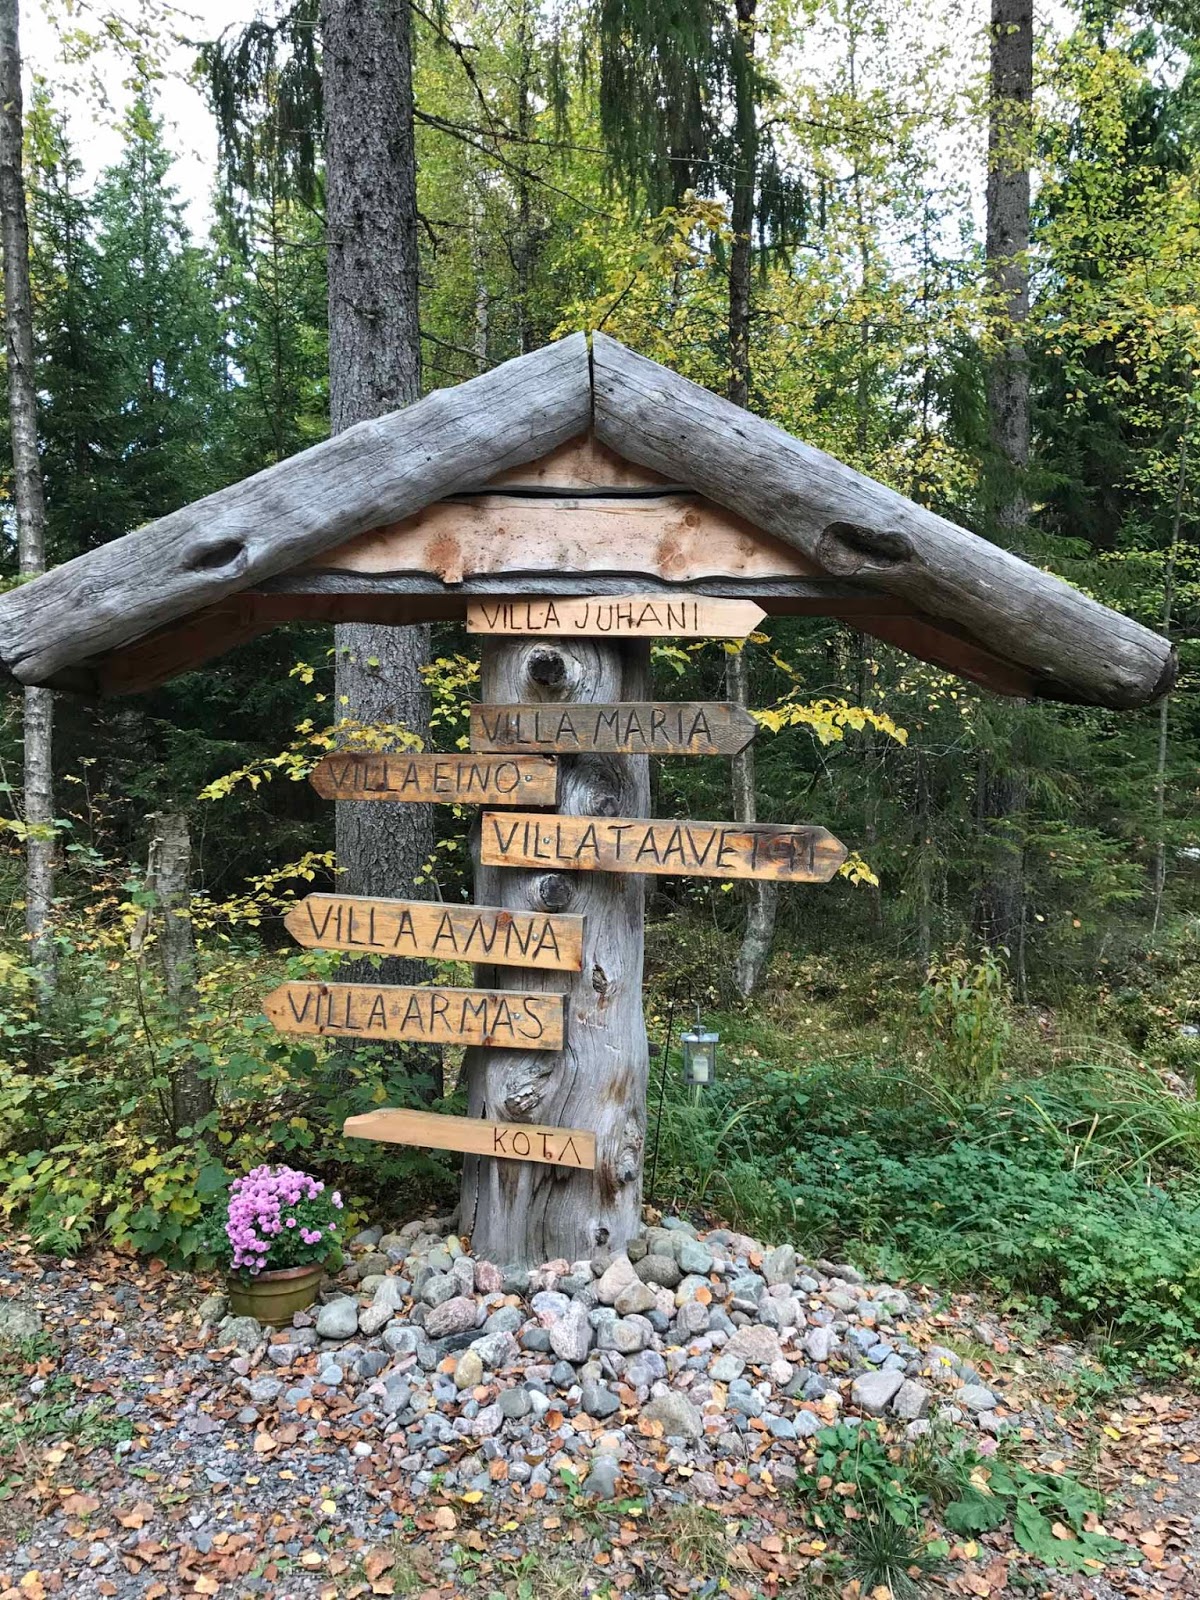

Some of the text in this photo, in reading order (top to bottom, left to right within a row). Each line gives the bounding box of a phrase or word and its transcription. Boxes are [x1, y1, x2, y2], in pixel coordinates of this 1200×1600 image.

[479, 602, 698, 631] VILLA JUHANI
[481, 708, 713, 746] VILLA MARIA
[328, 760, 520, 793] VILLA EINO
[493, 820, 815, 874] VILLA TAAVETTI
[307, 902, 560, 961] VILLA ANNA
[288, 990, 543, 1039] VILLA ARMAS
